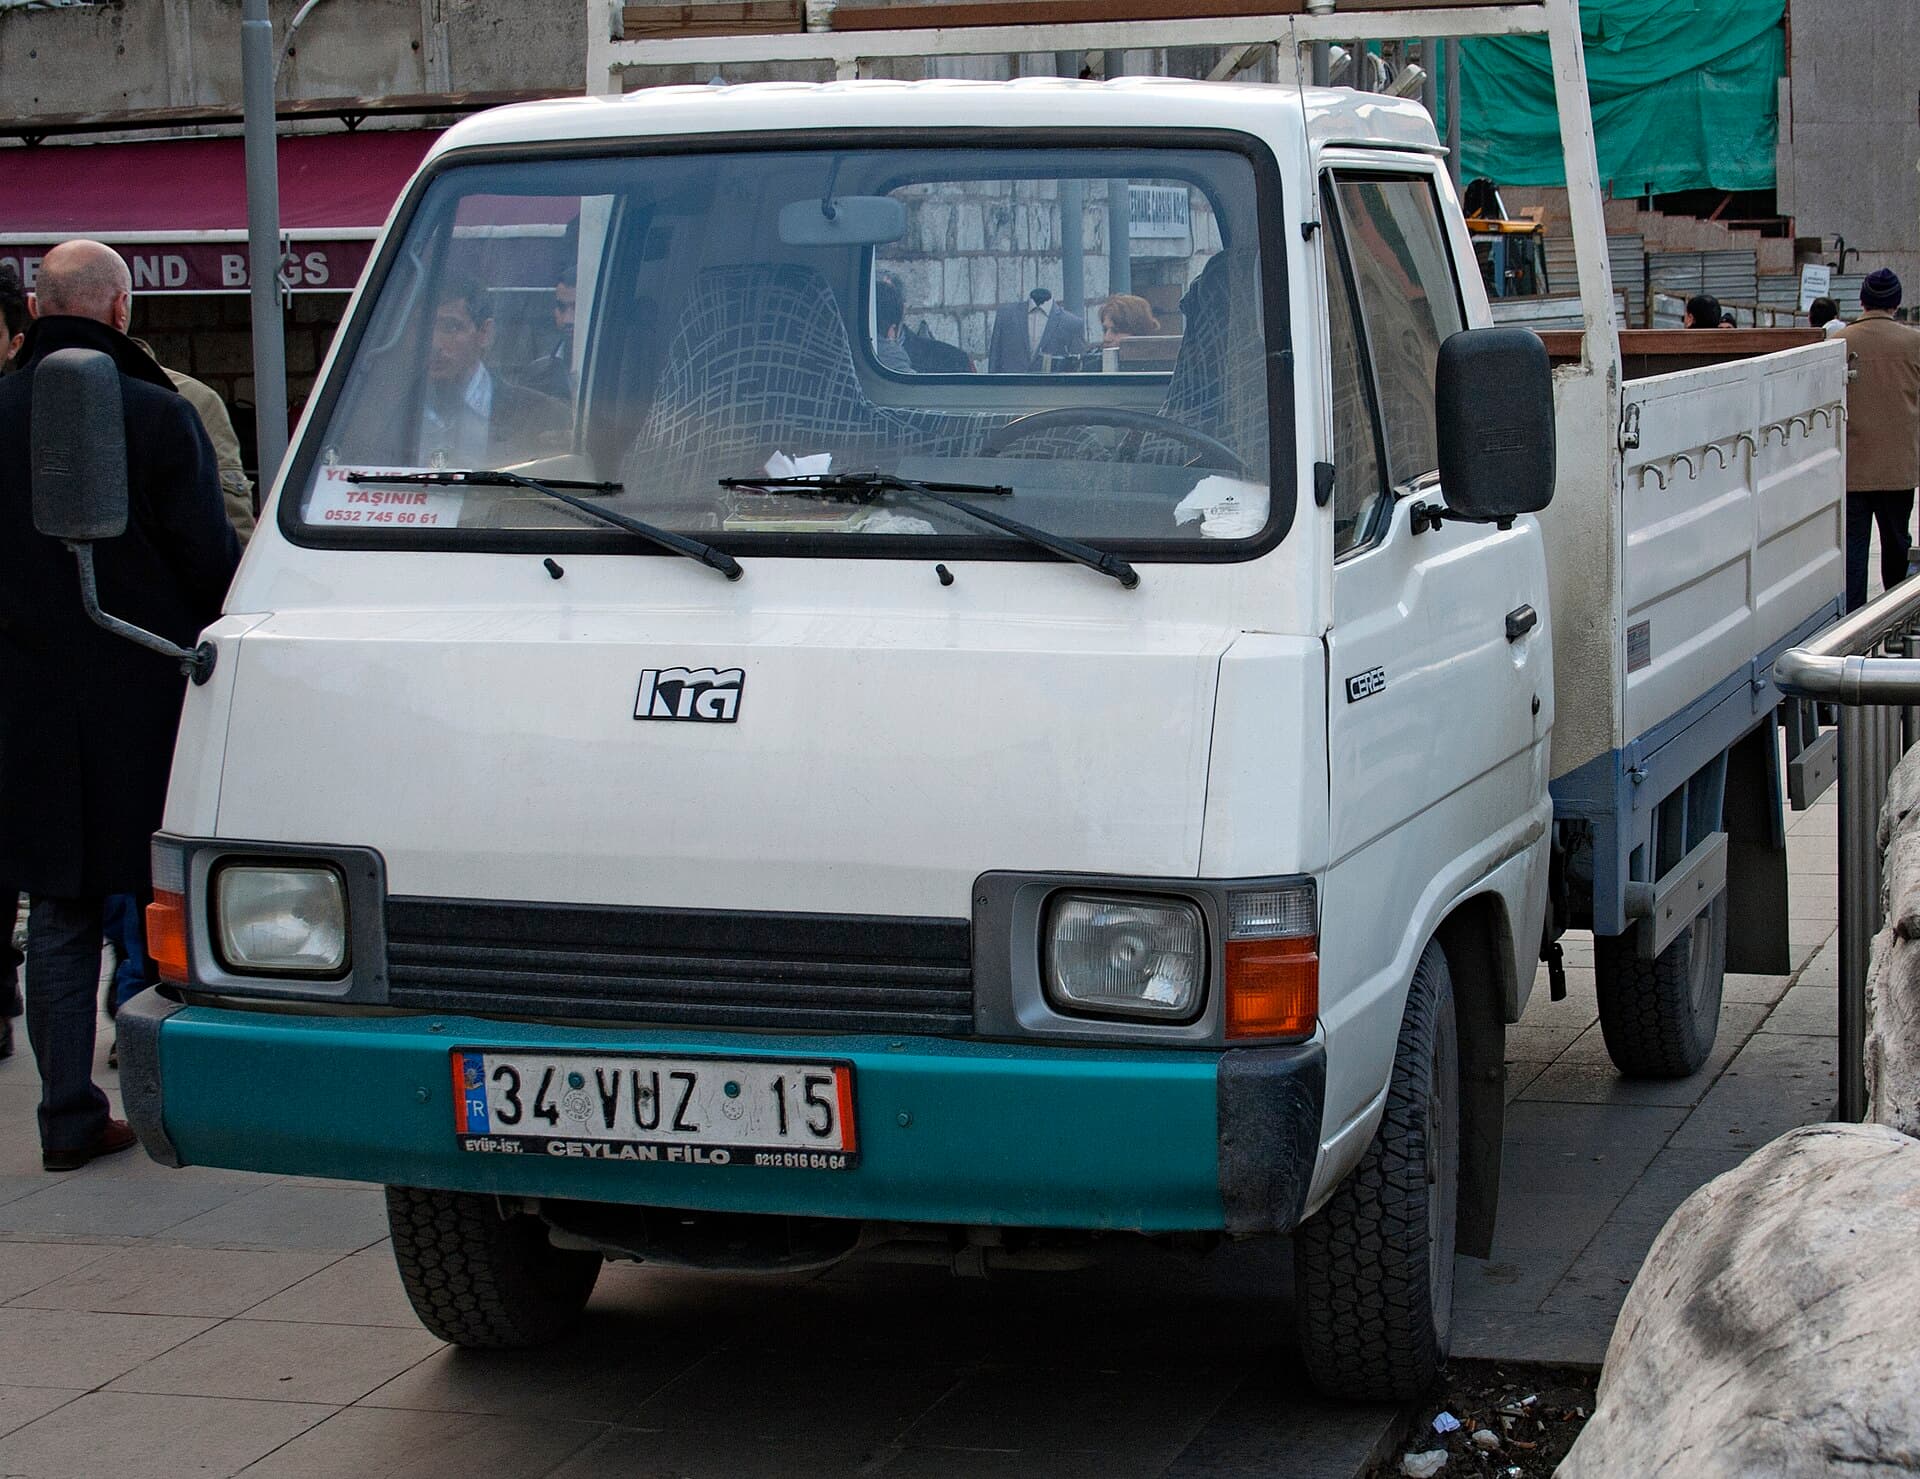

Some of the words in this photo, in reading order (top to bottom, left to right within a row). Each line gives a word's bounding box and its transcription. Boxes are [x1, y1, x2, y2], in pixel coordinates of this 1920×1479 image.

[132, 255, 188, 288] ND
[221, 252, 329, 287] BGS
[346, 491, 428, 507] TAŞINIR
[324, 509, 361, 522] 0532
[366, 511, 393, 523] 745
[397, 512, 416, 524] 60
[420, 513, 438, 524] 61
[1346, 667, 1386, 702] CERES
[492, 1065, 560, 1127] 34
[596, 1068, 699, 1132] VUZ
[772, 1074, 833, 1137] 15
[547, 1140, 658, 1161] CEYLAN
[754, 1153, 782, 1167] 0212
[784, 1153, 808, 1168] 616
[810, 1154, 827, 1169] 64
[829, 1155, 846, 1170] 64
